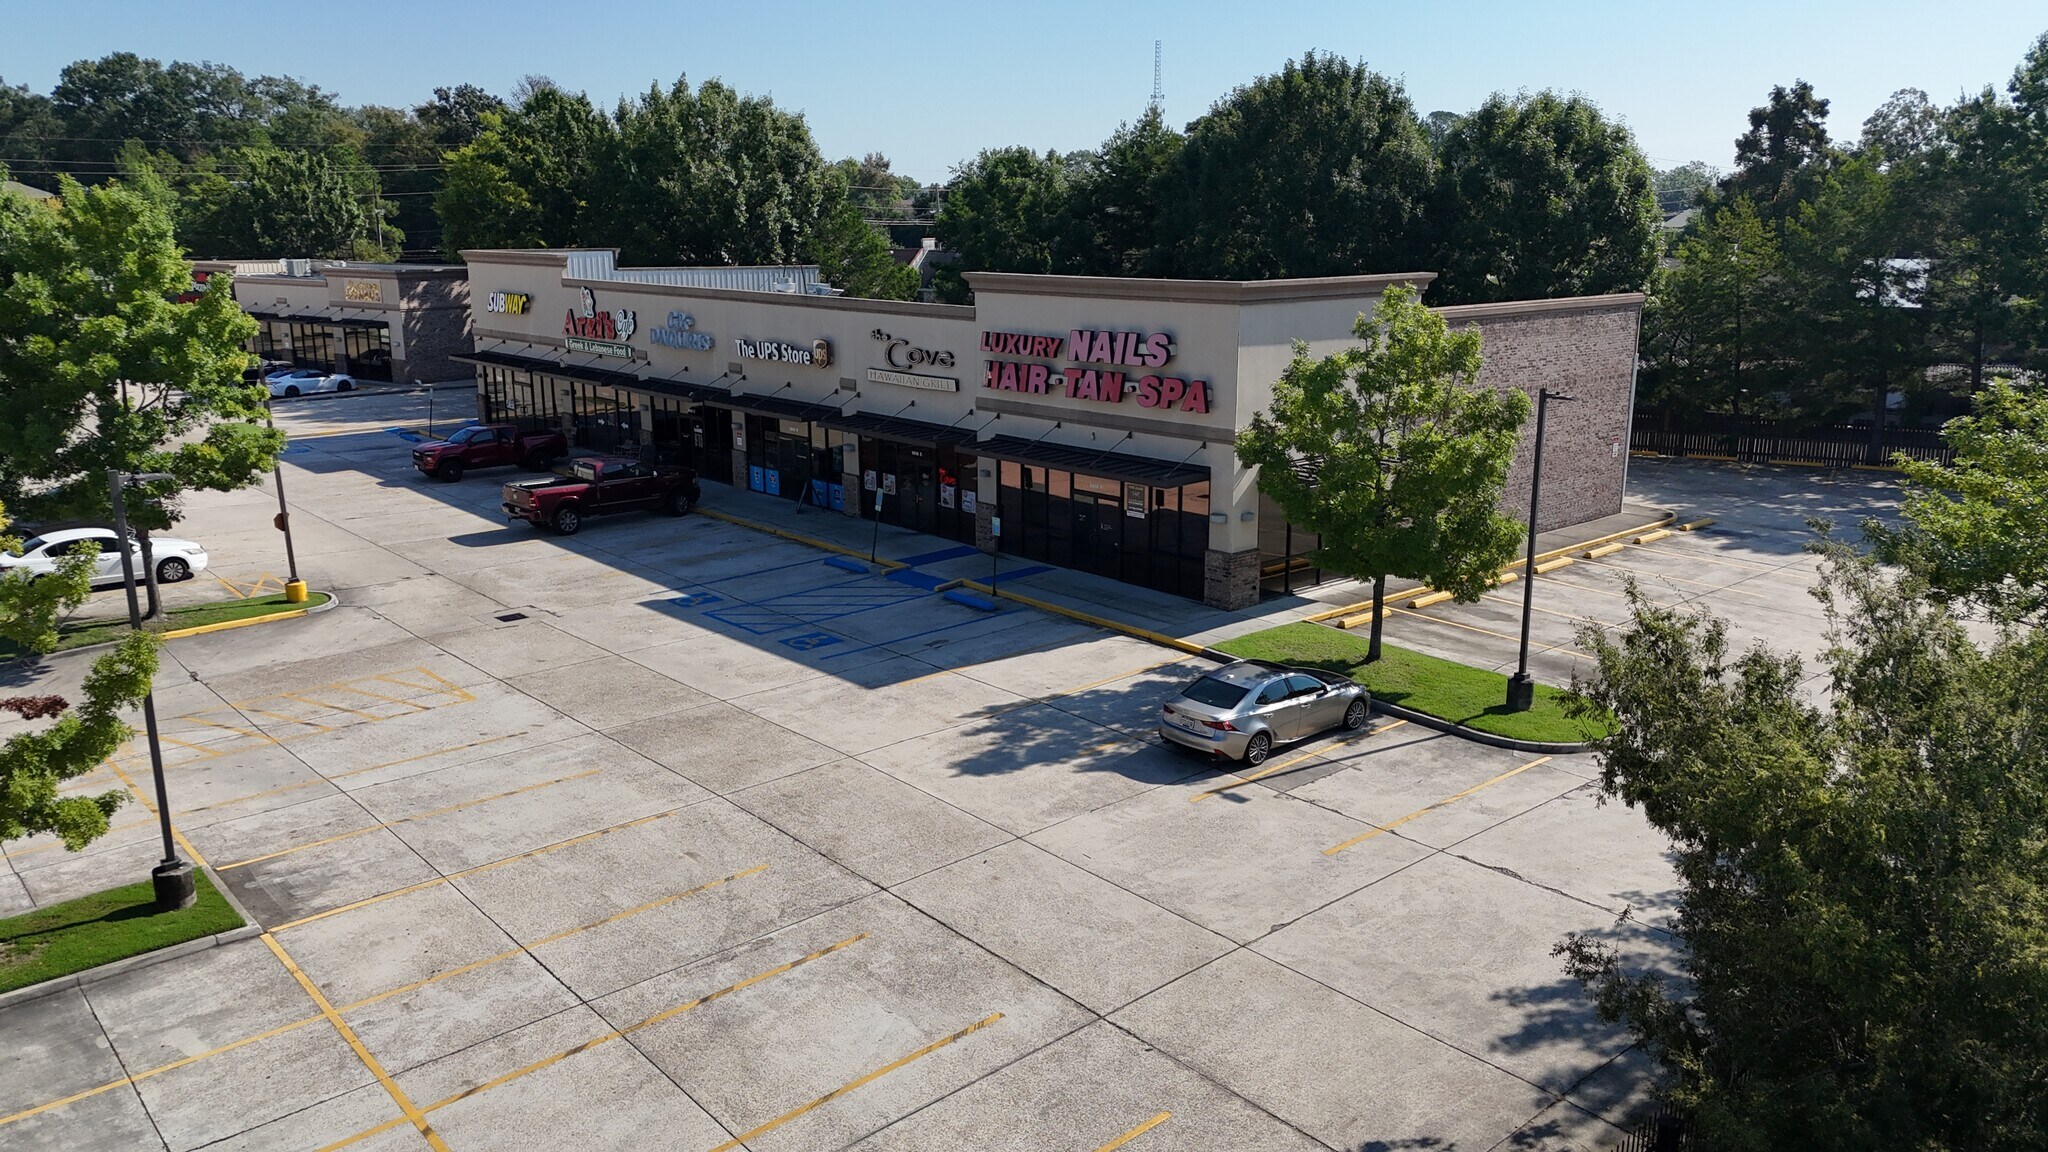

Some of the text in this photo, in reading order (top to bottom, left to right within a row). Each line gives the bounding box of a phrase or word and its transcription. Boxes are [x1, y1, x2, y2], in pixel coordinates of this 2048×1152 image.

[487, 292, 529, 315] SUBWAY
[562, 308, 617, 340] Arzi's
[870, 328, 891, 341] the
[569, 339, 584, 351] Greek
[589, 342, 613, 355] Lebanese
[614, 345, 626, 356] Food
[734, 339, 811, 365] The UPS Store
[885, 338, 956, 372] Cove
[980, 329, 1171, 368] LUXURY NAILS
[869, 370, 952, 390] HAWAIIAN GRILL
[983, 360, 1210, 414] HAIR TAN SPA
